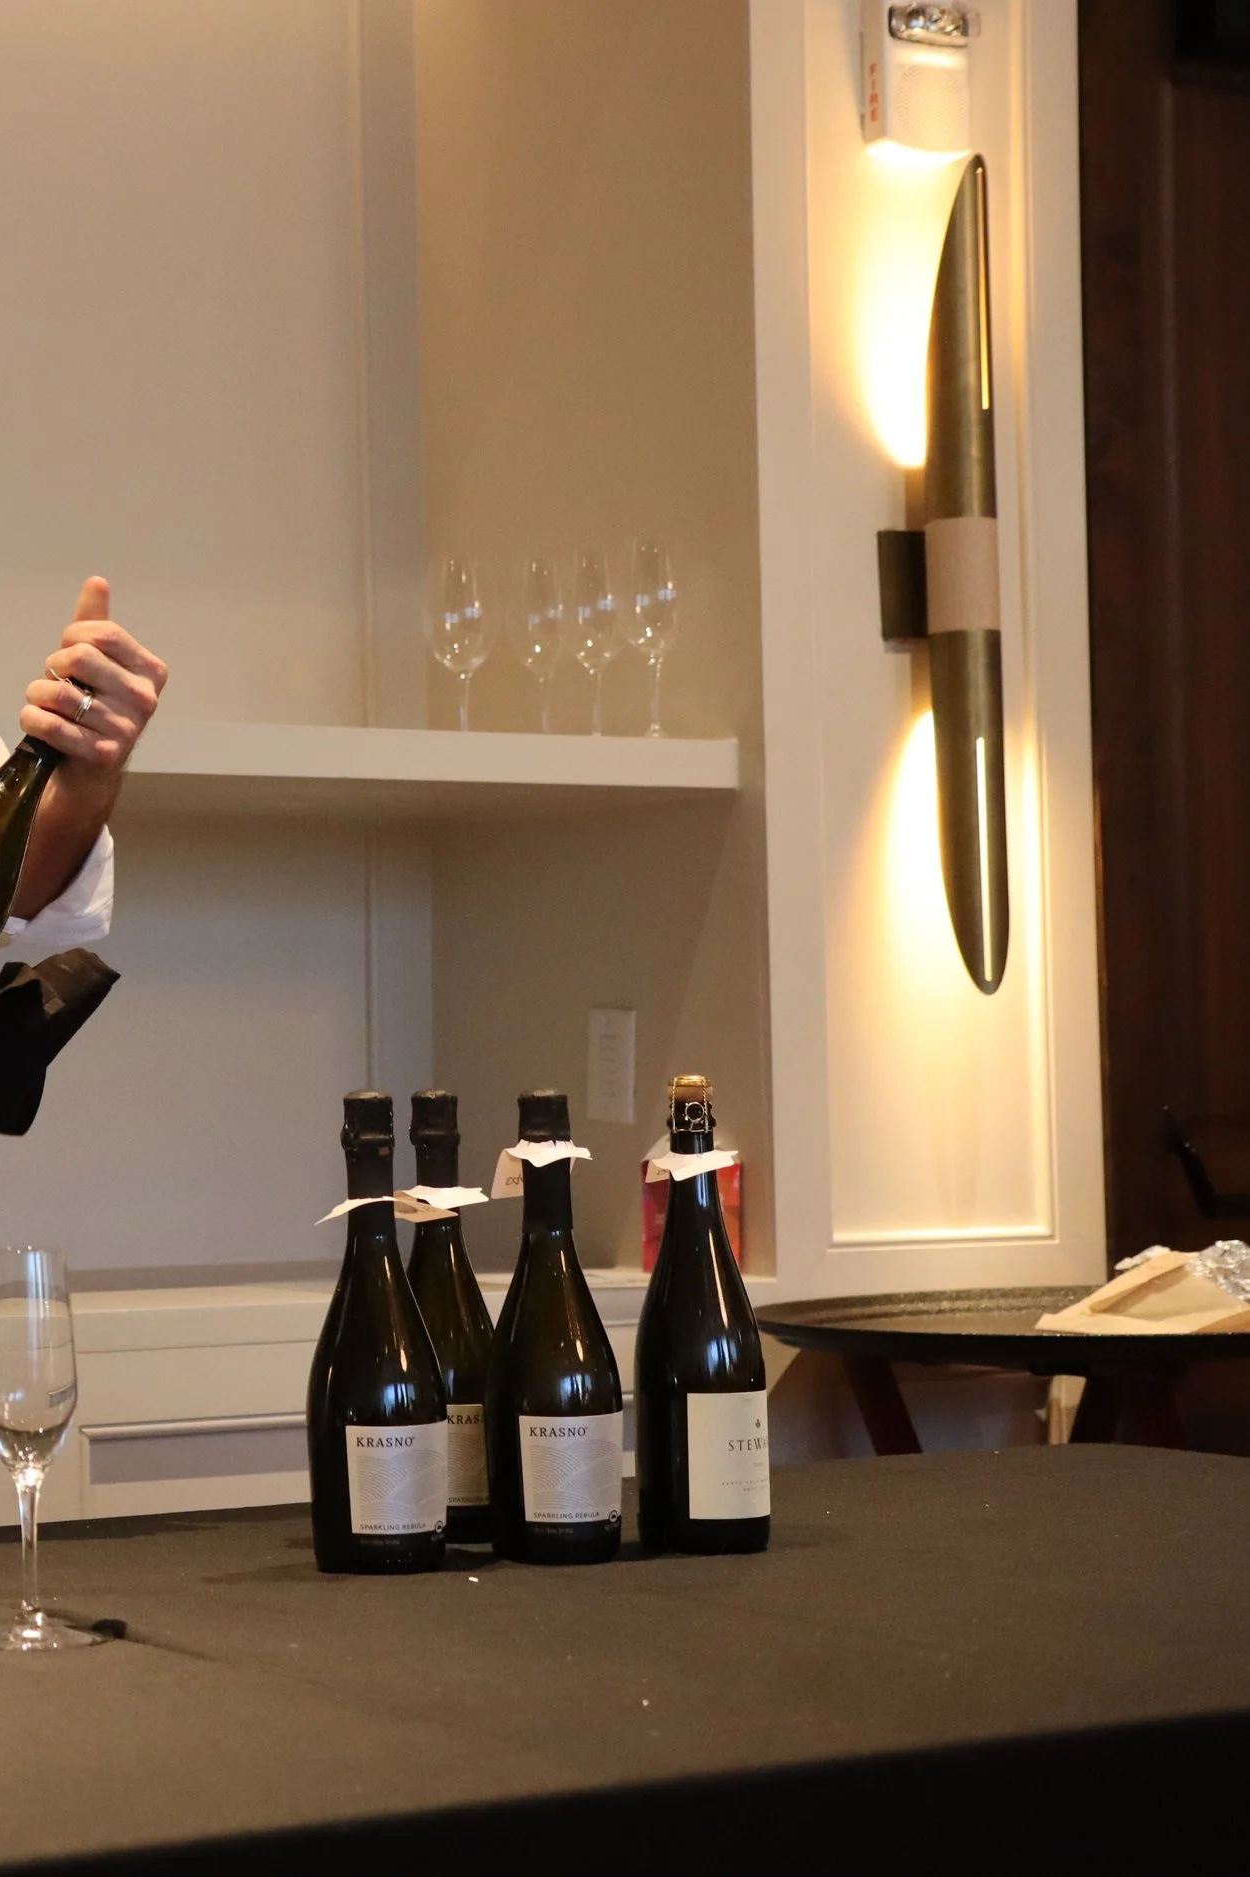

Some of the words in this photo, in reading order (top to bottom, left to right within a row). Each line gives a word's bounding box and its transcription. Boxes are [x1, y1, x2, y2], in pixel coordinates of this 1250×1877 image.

[529, 1426, 586, 1437] KRASNO
[356, 1437, 413, 1448] KRASNO
[533, 1511, 573, 1519] SPARKLING
[360, 1523, 400, 1531] SPARKLING
[402, 1523, 426, 1531] REBULA
